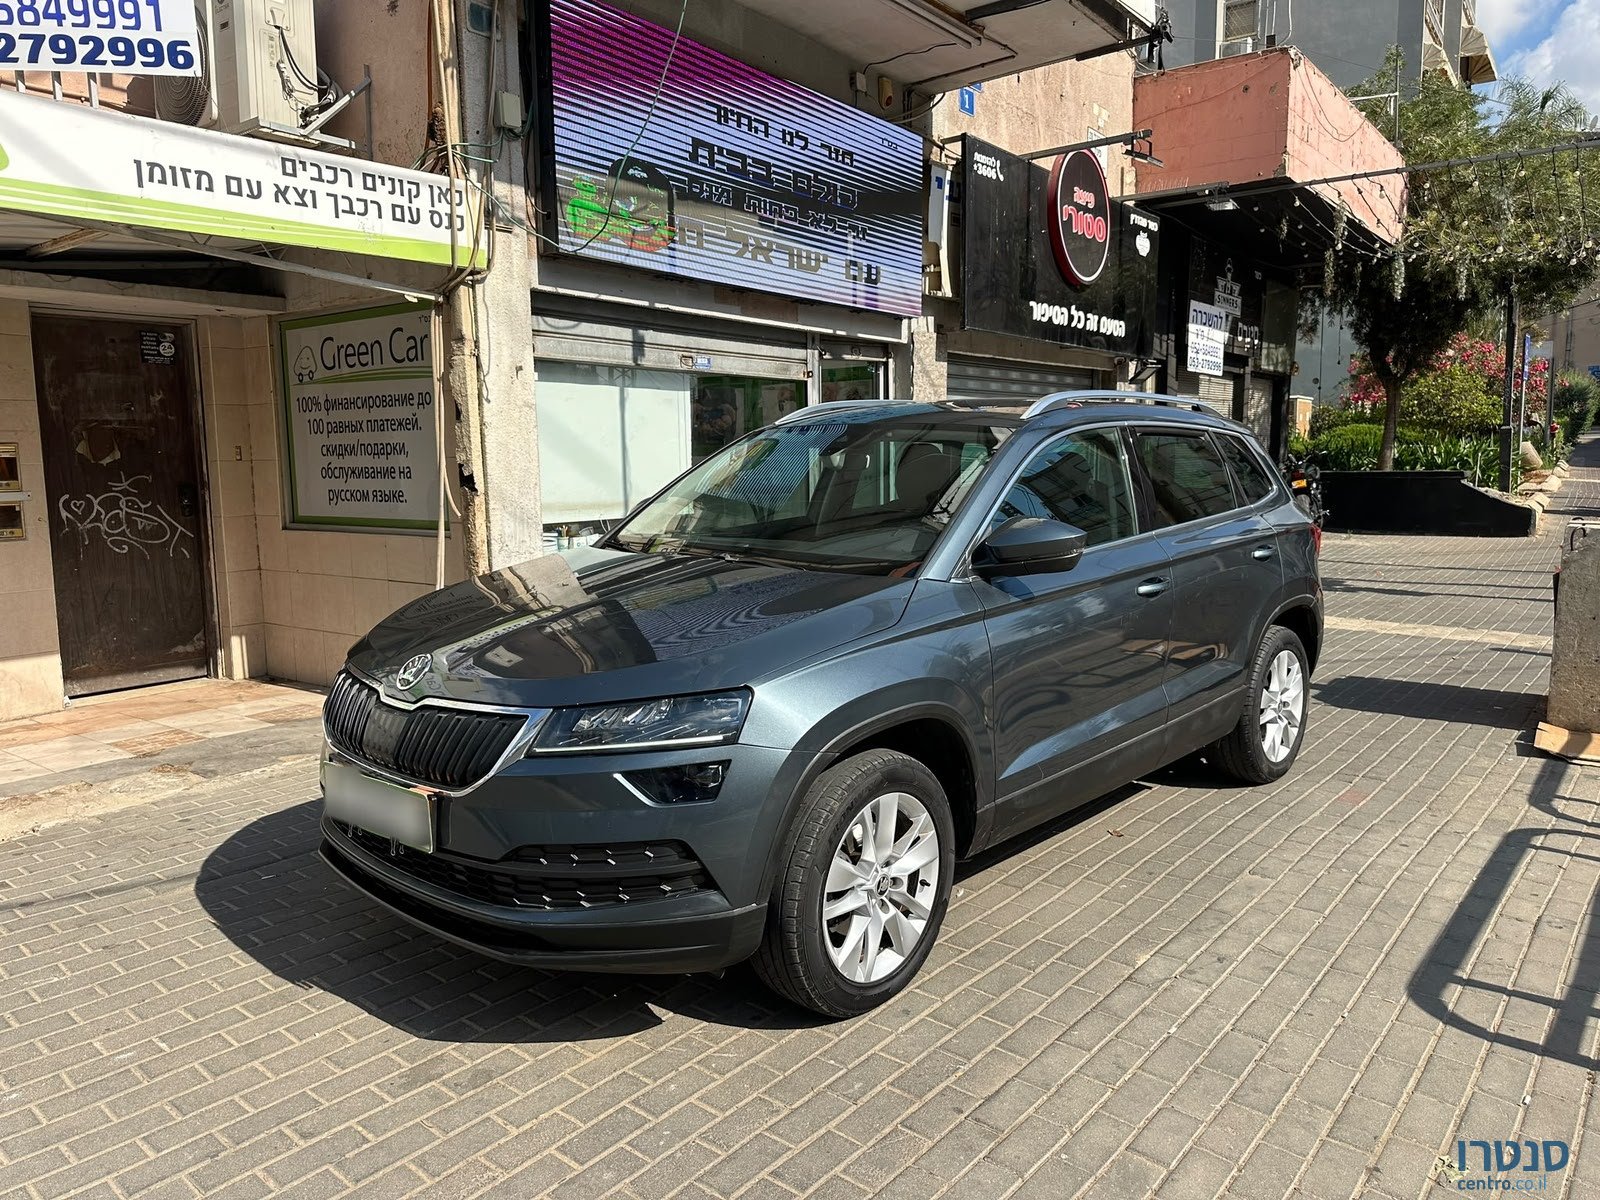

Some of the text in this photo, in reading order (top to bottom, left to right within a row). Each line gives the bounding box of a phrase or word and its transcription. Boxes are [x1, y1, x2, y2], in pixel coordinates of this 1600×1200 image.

[0, 33, 194, 70] 2792996
[133, 159, 214, 193] מזומן
[281, 156, 353, 188] רכבים
[225, 175, 263, 200] עם
[273, 183, 317, 209] וצא
[362, 172, 420, 204] קונים
[1073, 186, 1095, 208] פיצה
[326, 192, 383, 219] רכבך
[391, 203, 421, 225] עם
[1062, 205, 1106, 242] סטורי
[1029, 300, 1069, 326] הסיפור
[1070, 304, 1085, 329] כל
[1085, 312, 1099, 332] זה
[1192, 309, 1223, 330] להשכרה
[320, 327, 428, 371] Green Car
[296, 391, 432, 415] 100% финансирование до
[307, 412, 422, 437] 100 равных платежей.
[320, 439, 409, 460] скидки/подарки,
[320, 462, 412, 484] обслуживание на
[328, 488, 408, 506] русском языке.
